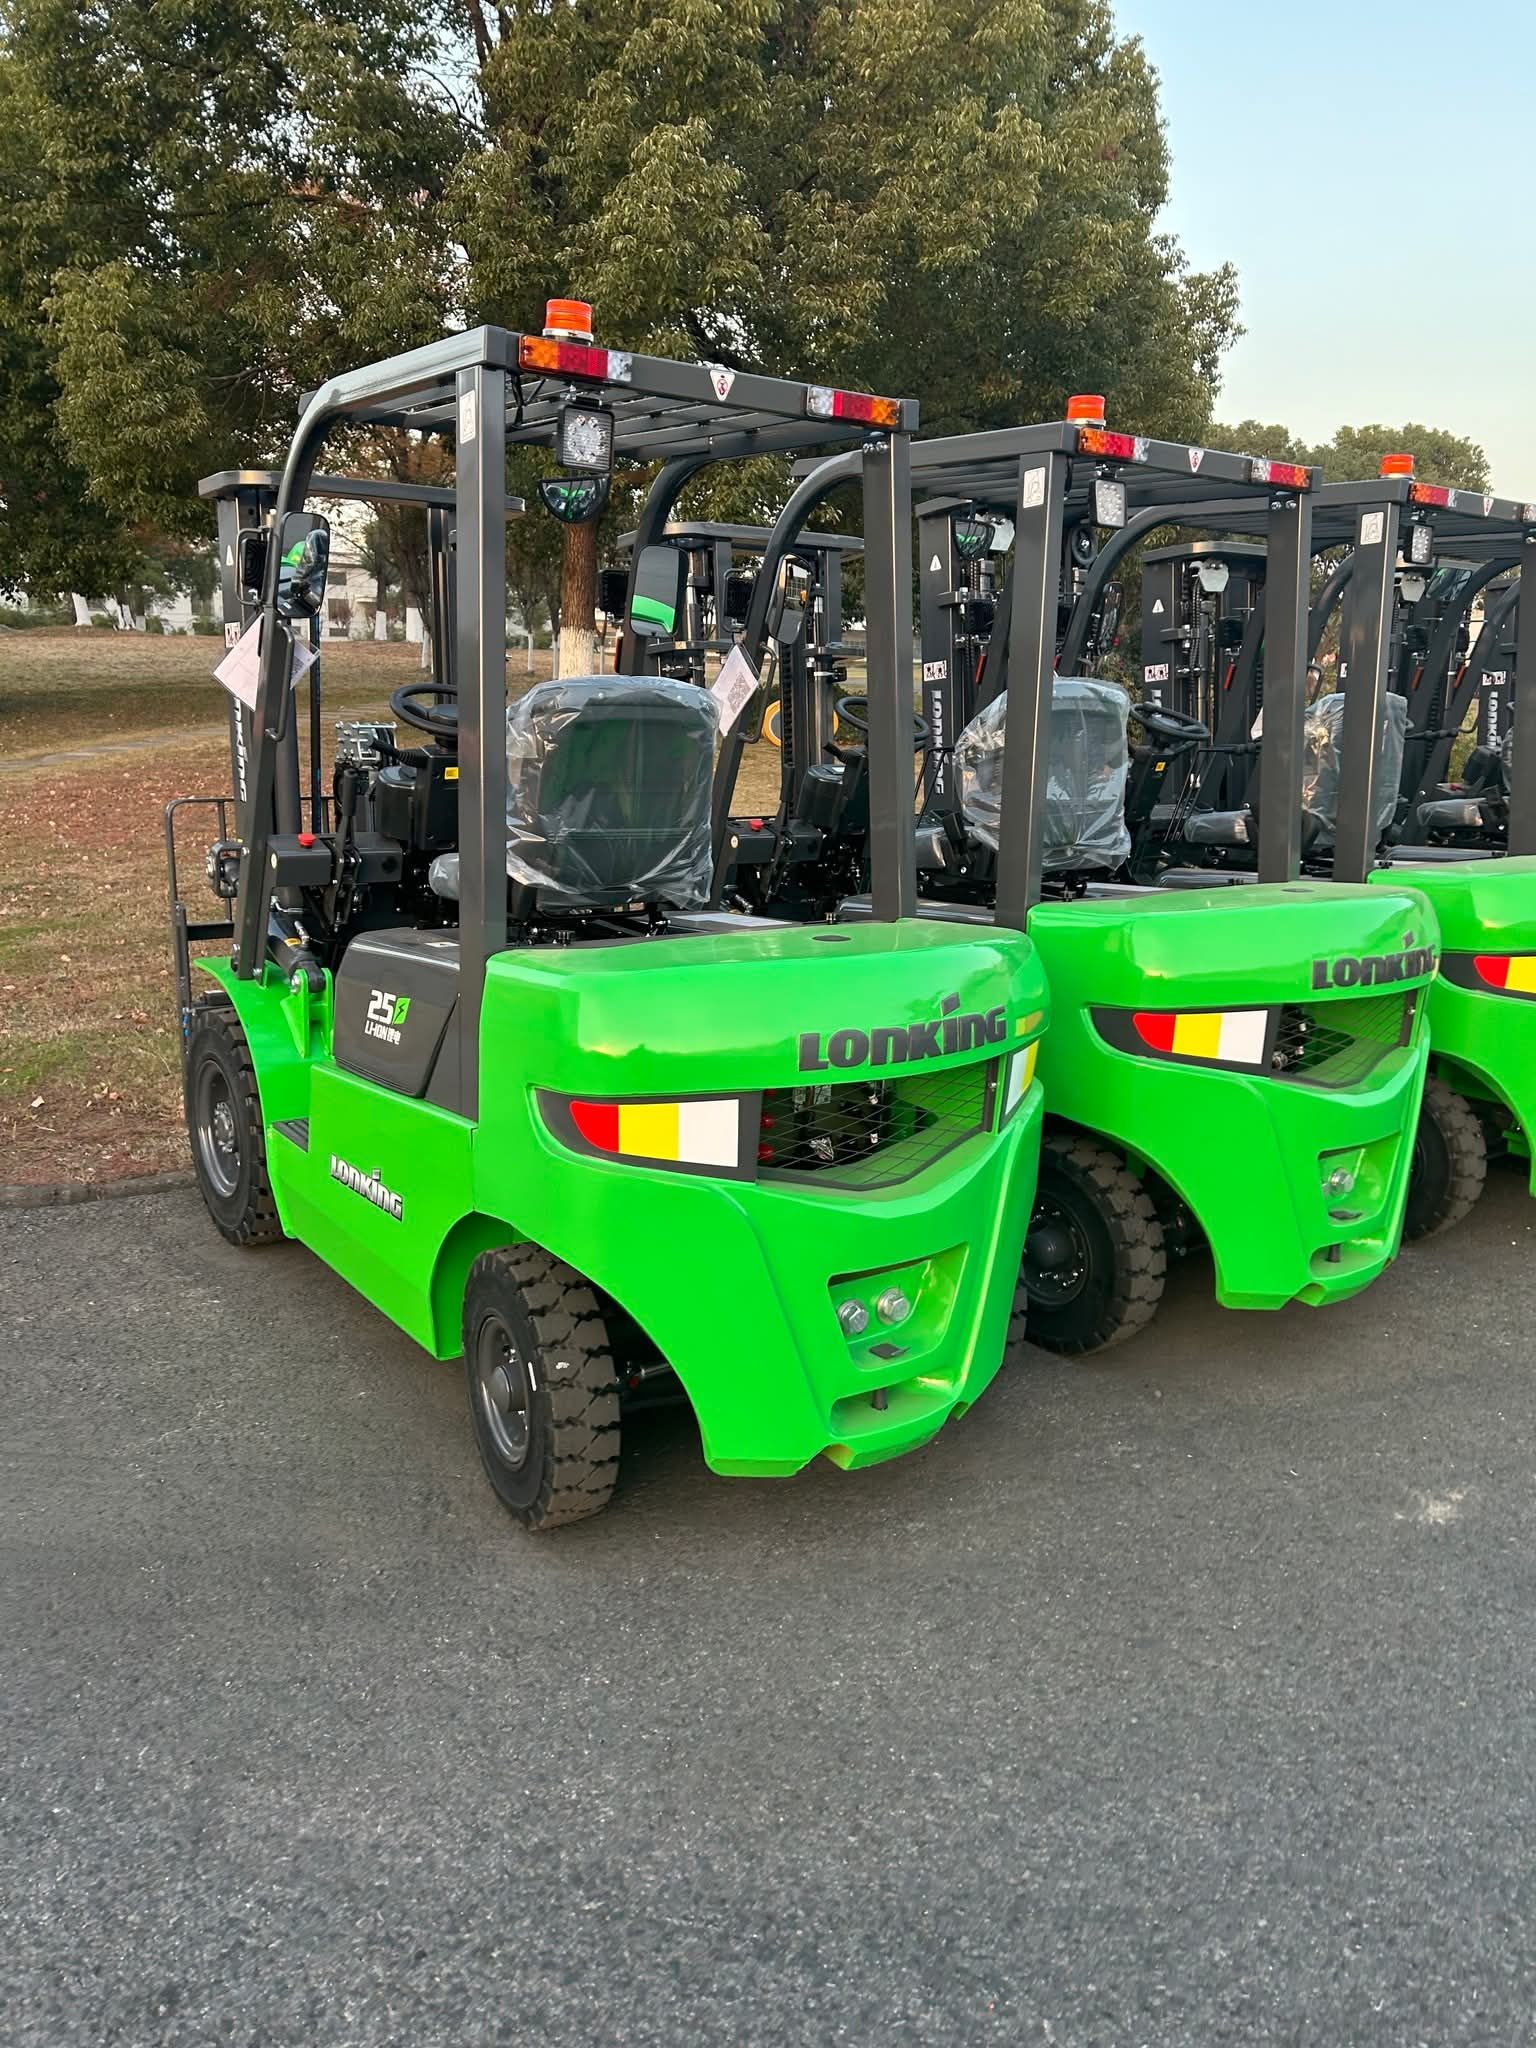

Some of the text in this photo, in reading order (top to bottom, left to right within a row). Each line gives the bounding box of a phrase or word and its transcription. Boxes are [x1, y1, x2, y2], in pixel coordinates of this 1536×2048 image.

[367, 989, 397, 1024] 25
[799, 992, 1006, 1071] LONKING
[330, 1153, 403, 1222] LONKING
